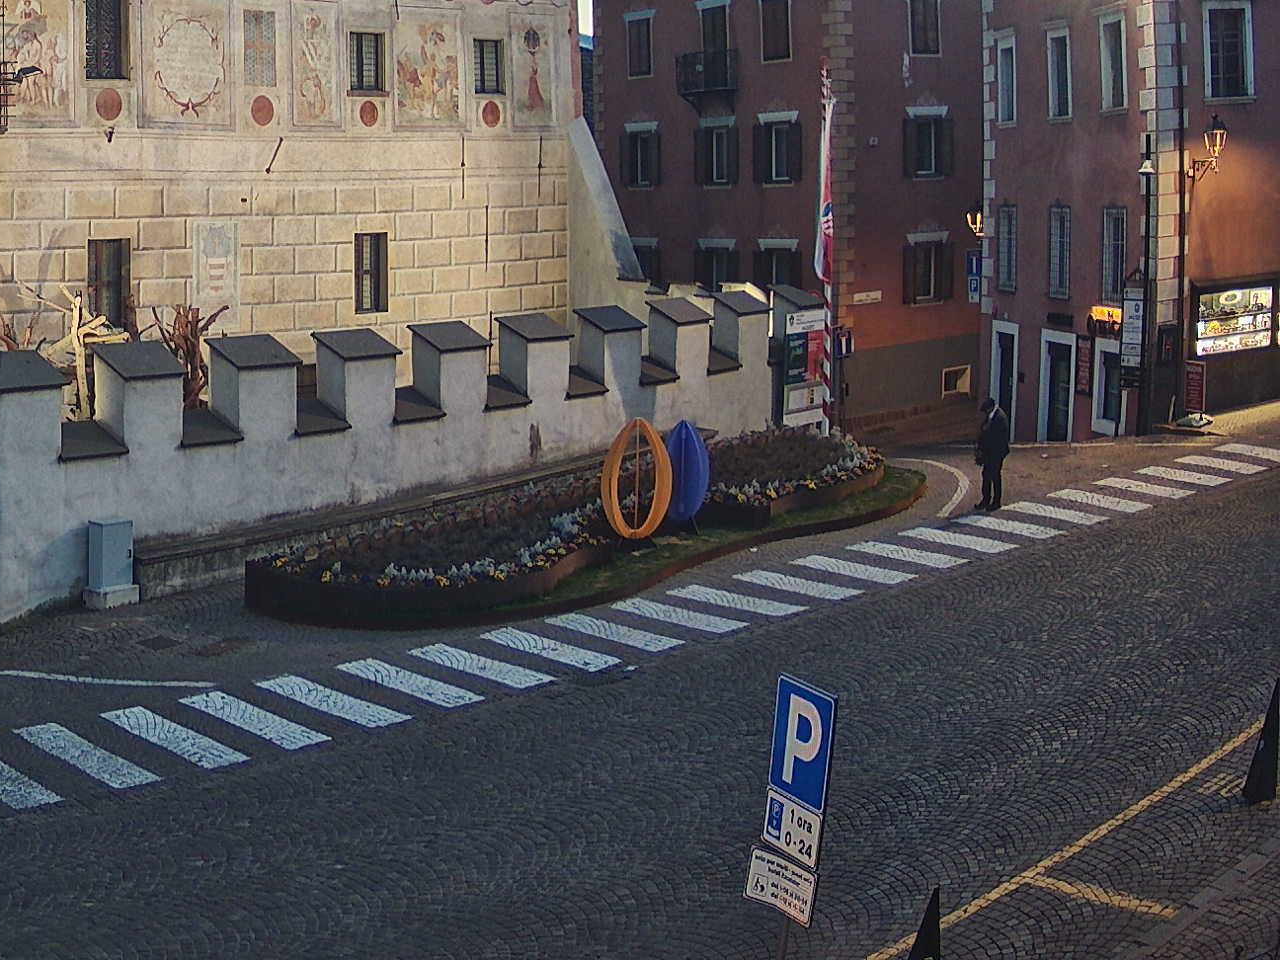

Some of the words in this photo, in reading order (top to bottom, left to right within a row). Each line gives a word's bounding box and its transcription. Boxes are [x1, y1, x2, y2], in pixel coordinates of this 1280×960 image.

[782, 693, 822, 785] P
[790, 808, 795, 824] 1
[796, 816, 813, 834] ora
